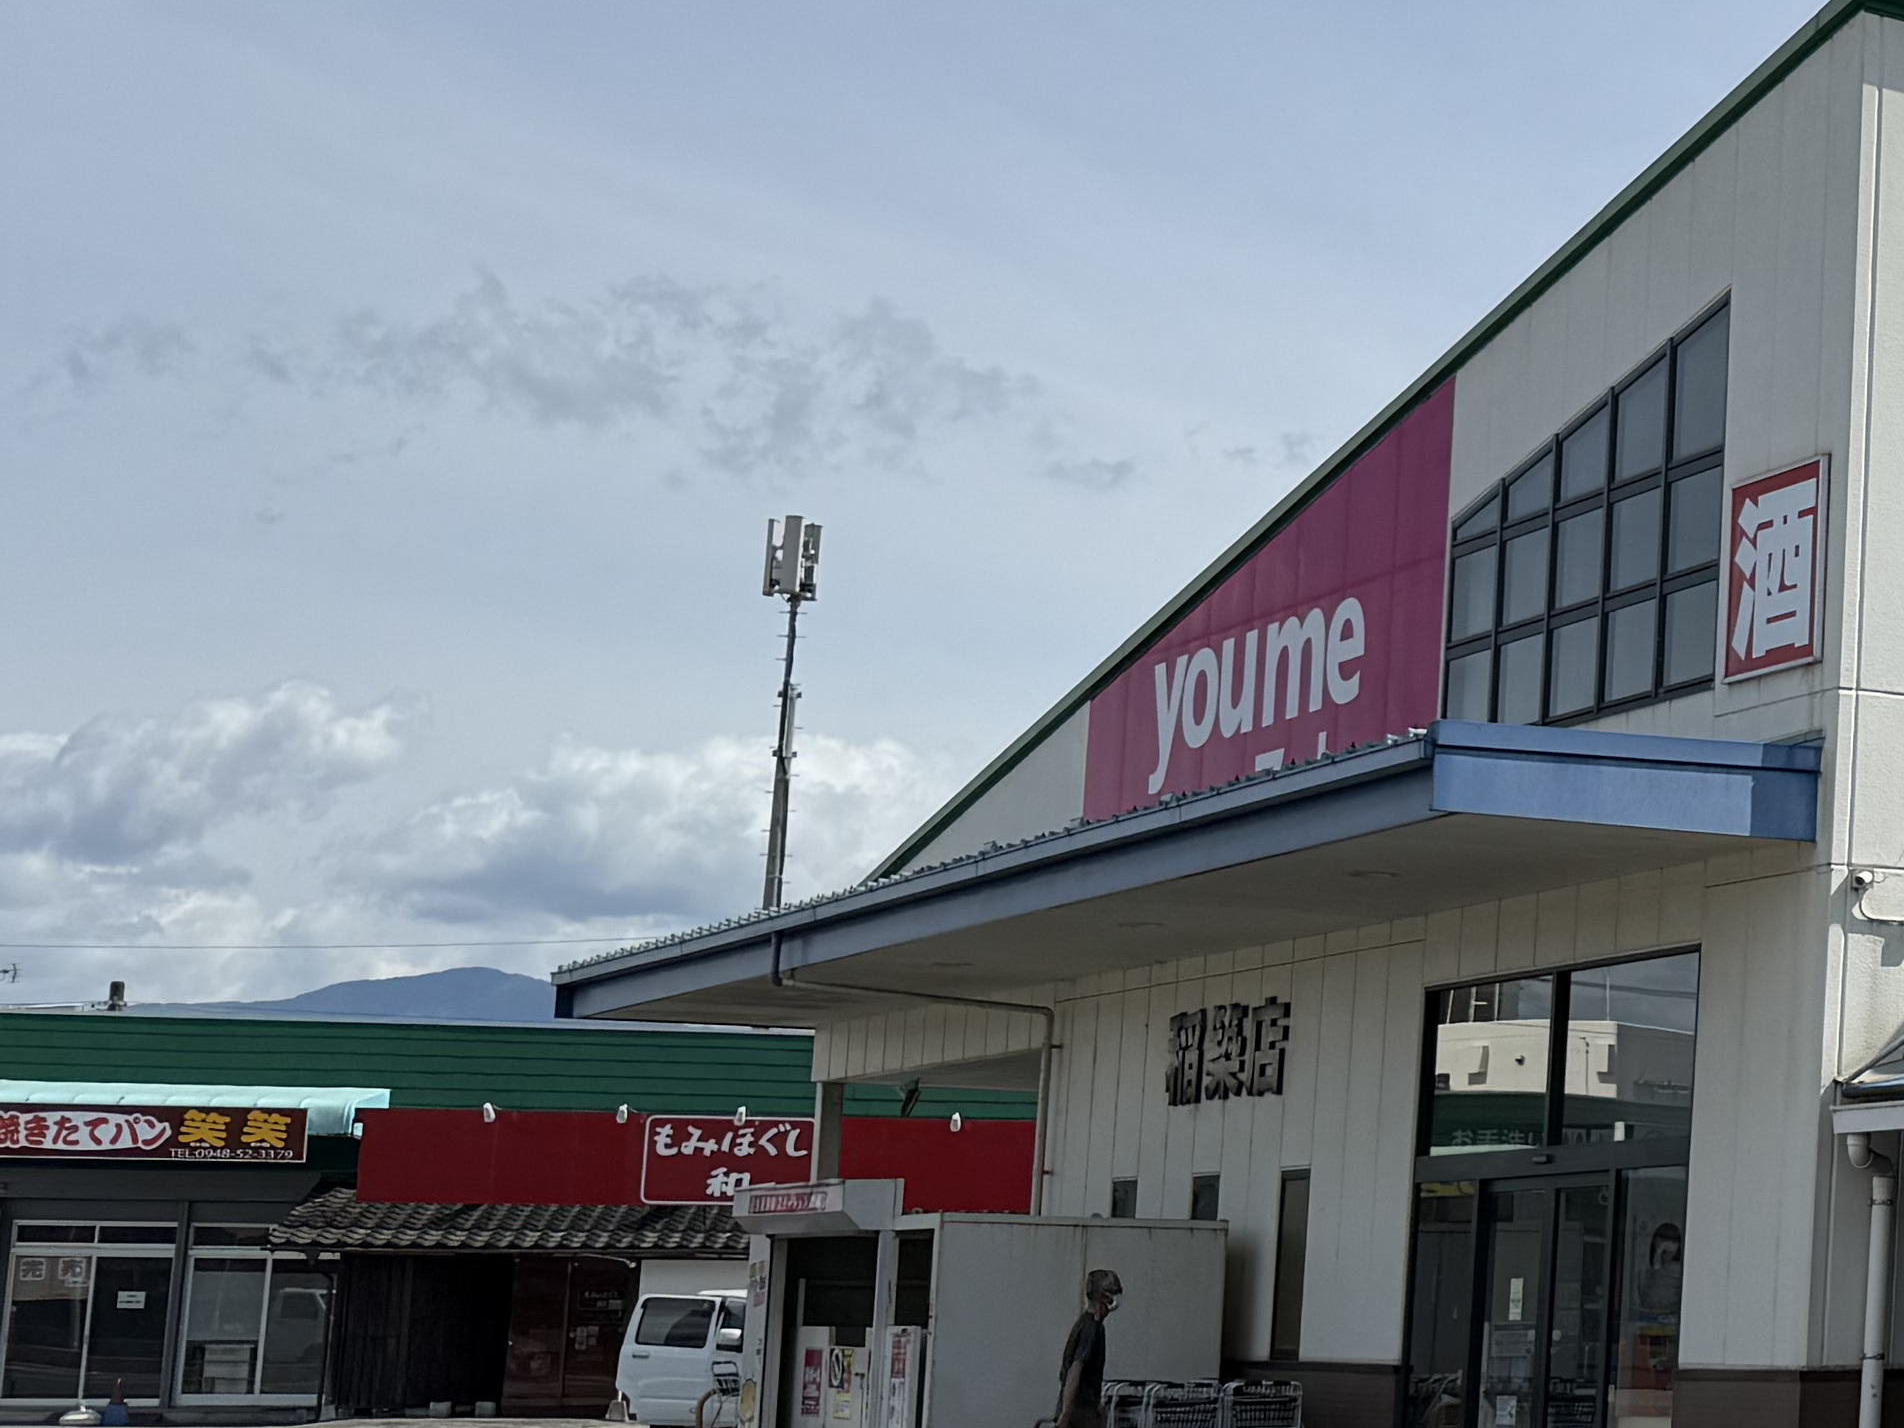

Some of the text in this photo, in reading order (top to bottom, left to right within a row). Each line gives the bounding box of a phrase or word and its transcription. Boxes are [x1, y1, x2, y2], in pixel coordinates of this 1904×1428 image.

[1731, 477, 1817, 661] 酒
[1148, 595, 1365, 795] youme
[654, 1123, 808, 1157] もみほぐし
